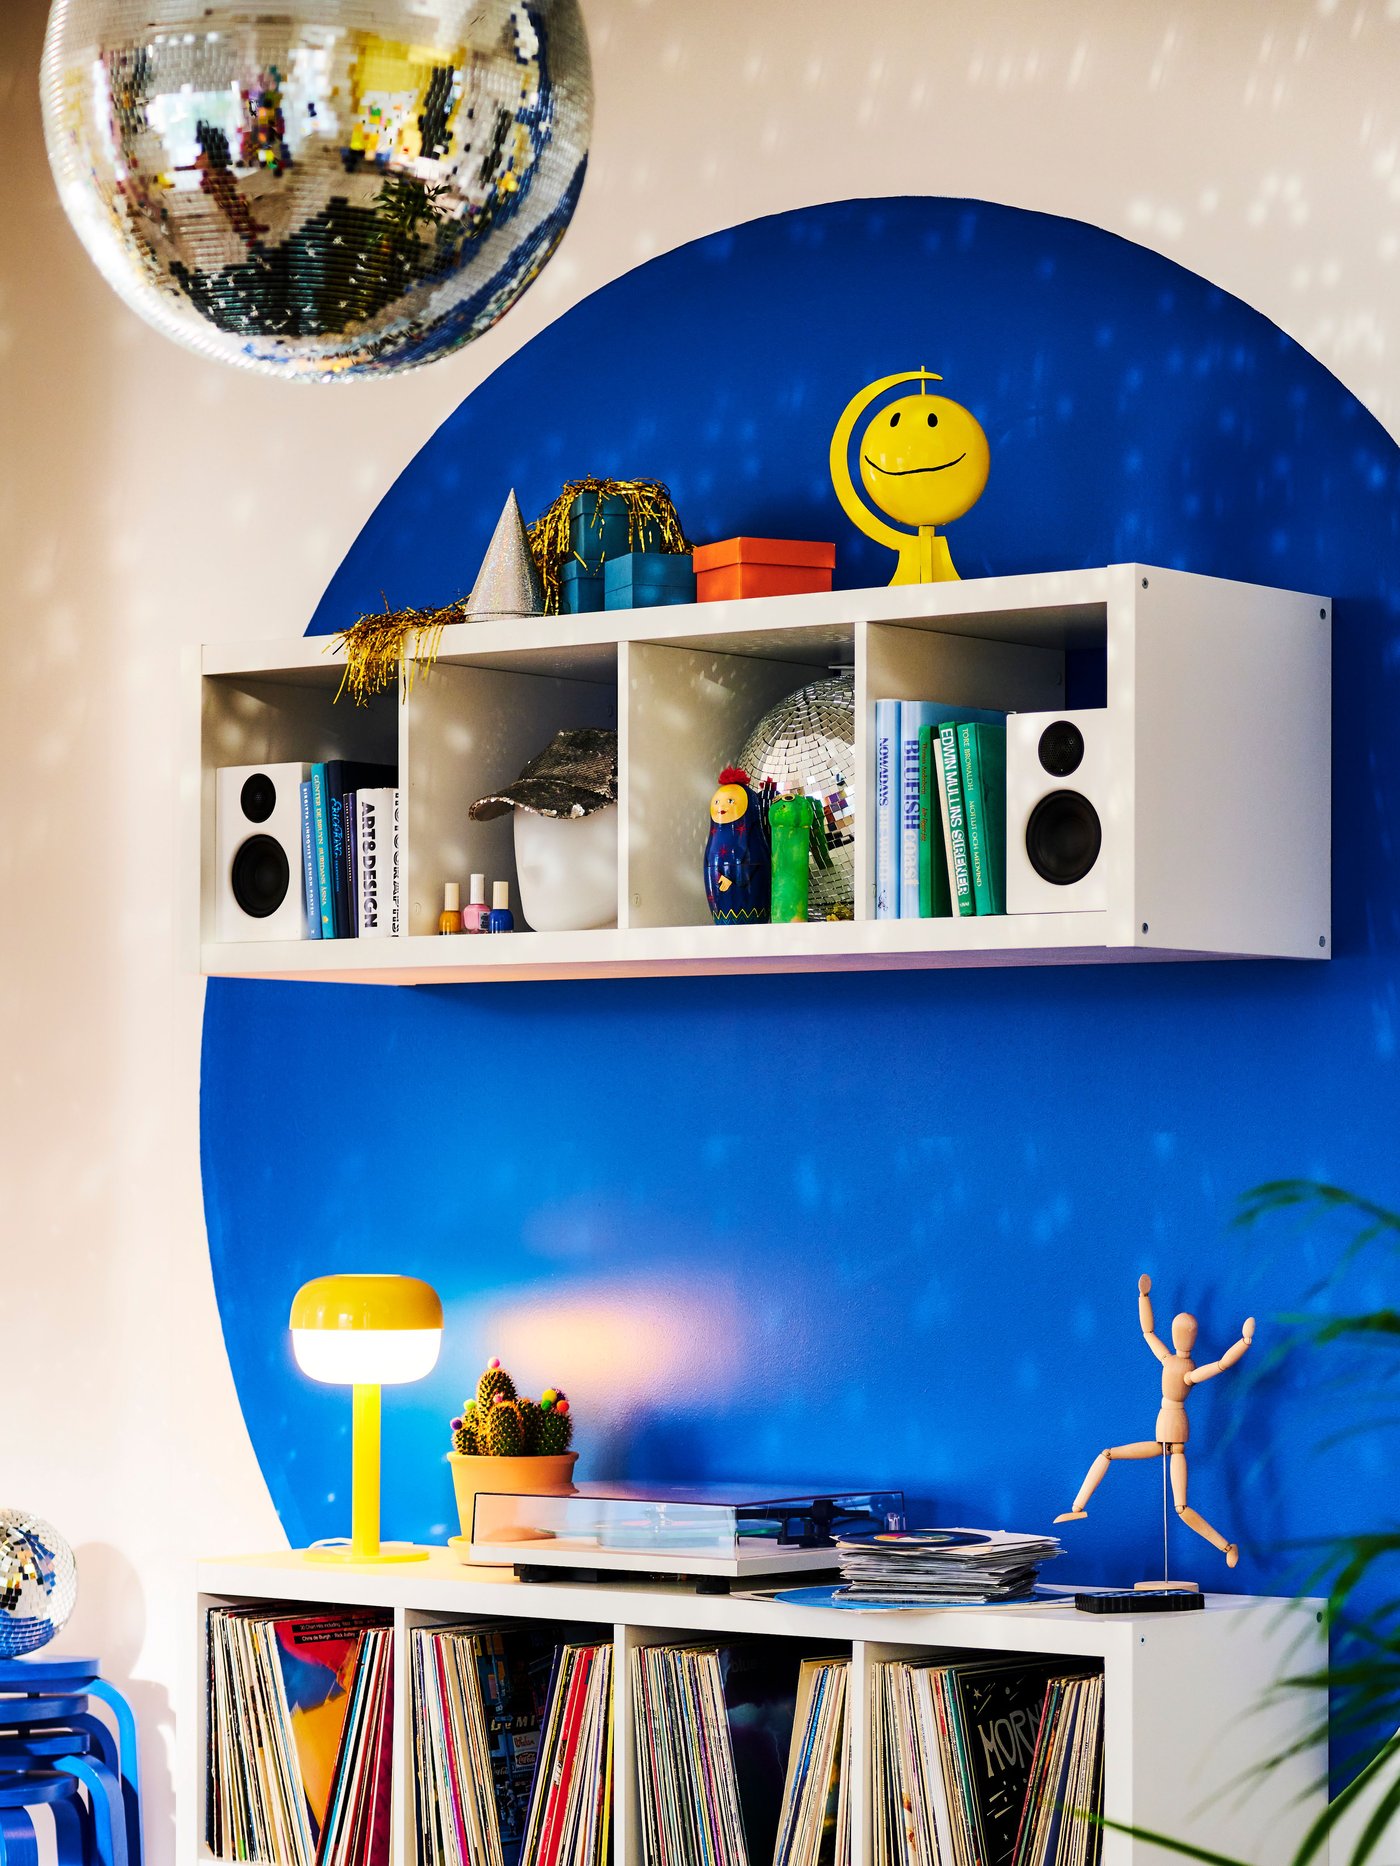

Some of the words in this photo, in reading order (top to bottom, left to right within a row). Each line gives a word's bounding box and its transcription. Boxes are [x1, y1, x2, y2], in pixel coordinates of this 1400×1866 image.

[941, 728, 957, 770] EDWIN
[962, 728, 970, 747] TORE
[879, 738, 889, 807] NOWADAYS
[964, 748, 974, 791] BROWALDH
[945, 772, 962, 827] MULLINS
[362, 802, 377, 928] ART&DESIGN
[951, 829, 969, 896] SIRENER
[974, 852, 982, 887] MEDVIND
